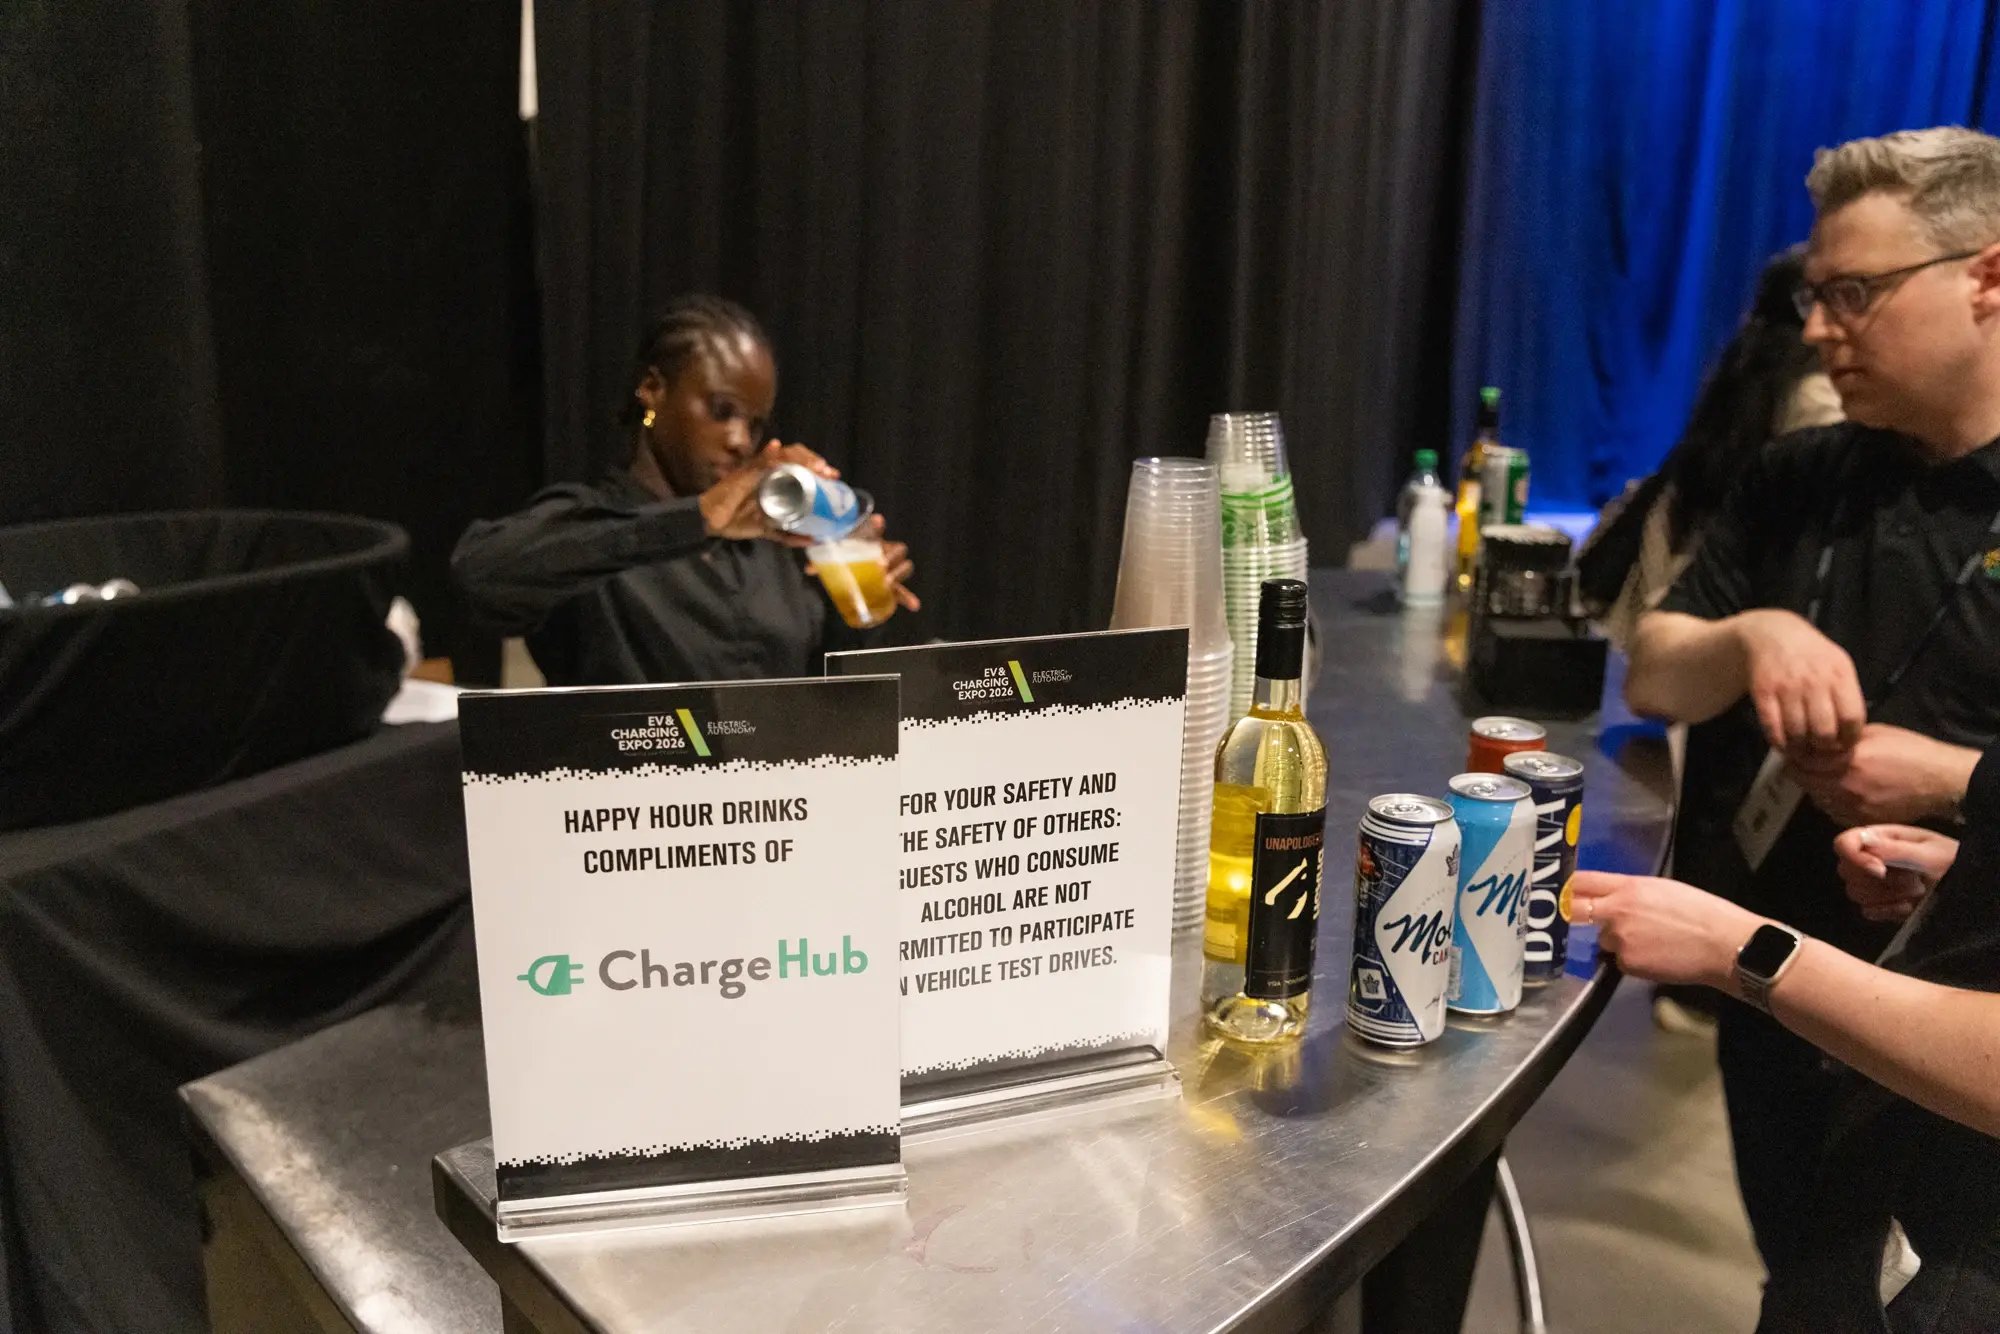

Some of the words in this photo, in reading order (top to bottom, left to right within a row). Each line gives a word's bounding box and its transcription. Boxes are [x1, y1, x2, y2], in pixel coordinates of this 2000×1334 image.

[952, 677, 1009, 690] CHARGING
[1032, 669, 1066, 679] ELECTRIC
[1032, 674, 1073, 684] AUTONOMY
[958, 689, 987, 700] EXPO
[989, 687, 1014, 698] 2026
[611, 727, 679, 740] CHARGING
[707, 720, 747, 729] ELECTRIC
[707, 727, 756, 736] AUTONOMY
[618, 740, 652, 751] EXPO
[655, 738, 685, 749] 2026
[900, 792, 937, 817] FOR
[944, 785, 996, 811] YOUR
[1003, 777, 1073, 804] SAFETY
[1079, 772, 1117, 796] AND
[565, 807, 641, 834] HAPPY
[649, 803, 714, 829] HOUR
[722, 798, 808, 825] DRINKS
[900, 830, 929, 853] HE
[936, 820, 1007, 849] SAFETY
[1014, 817, 1038, 839] OF
[1044, 808, 1122, 836] OTHERS:
[584, 842, 756, 874] COMPLIMENTS
[766, 839, 794, 862] OF
[975, 854, 1020, 879] WHO
[1027, 842, 1120, 873] CONSUME
[921, 892, 1007, 923] ALCOHOL
[1013, 886, 1049, 910] ARE
[1056, 880, 1092, 904] NOT
[989, 926, 1013, 948] TO
[1020, 908, 1135, 944] PARTICIPATE
[599, 936, 868, 999] ChargeHub
[915, 964, 992, 994] VEHICLE
[998, 956, 1043, 981] TEST
[1050, 946, 1118, 973] DRIVES.
